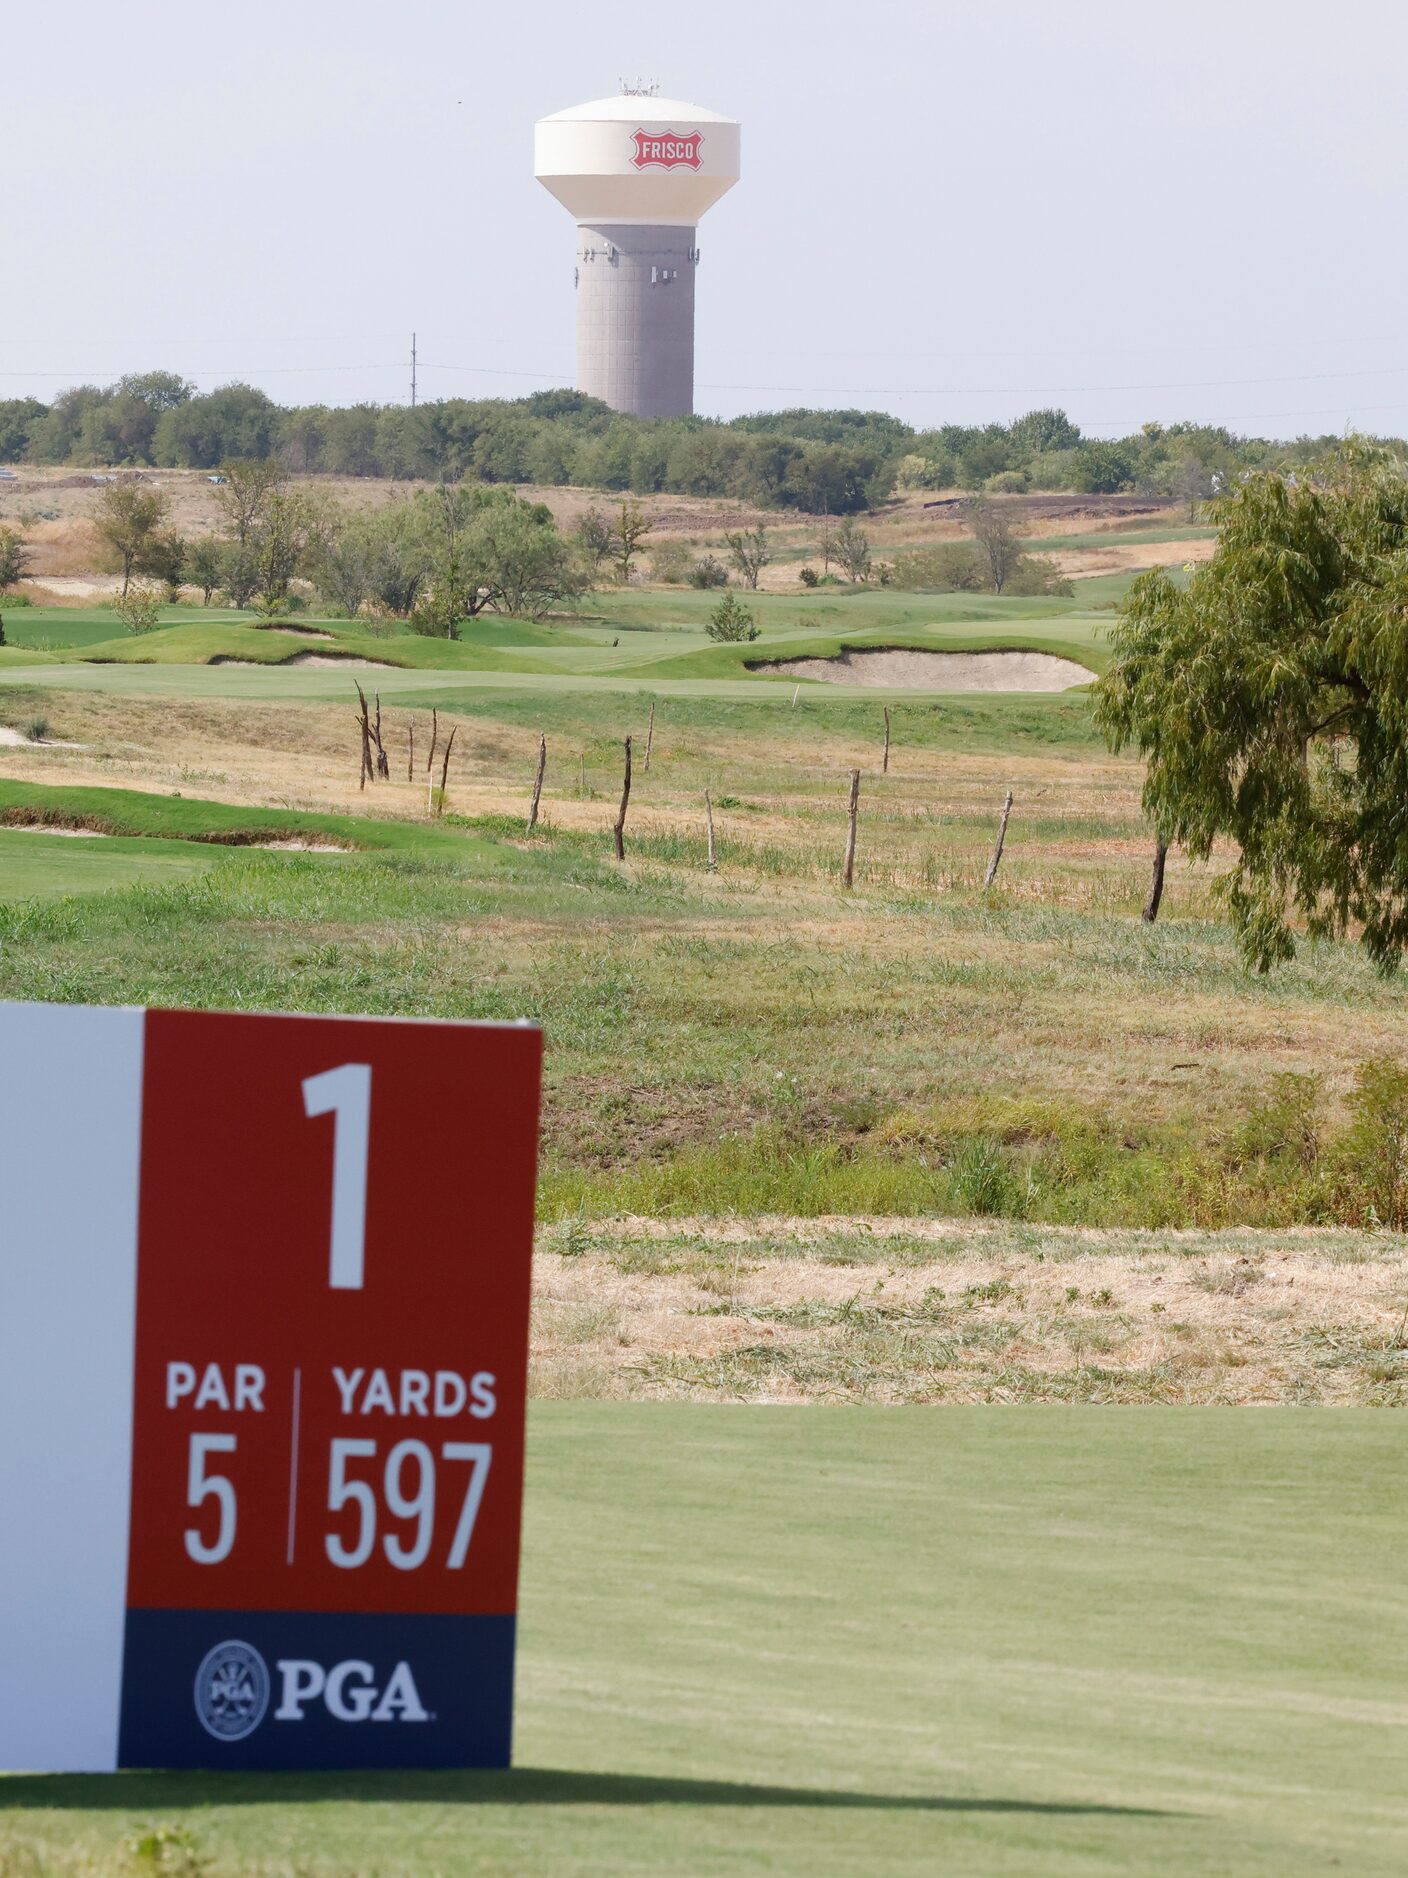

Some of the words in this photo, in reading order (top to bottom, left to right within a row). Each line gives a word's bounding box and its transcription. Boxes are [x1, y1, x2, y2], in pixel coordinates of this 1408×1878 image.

[642, 141, 694, 159] FRISCO
[301, 1063, 372, 1290] 1
[166, 1361, 266, 1412] PAR
[332, 1366, 498, 1419] YARDS
[184, 1432, 237, 1565] 5
[325, 1437, 493, 1571] 597
[210, 1679, 256, 1701] PGA
[274, 1659, 429, 1722] PGA
